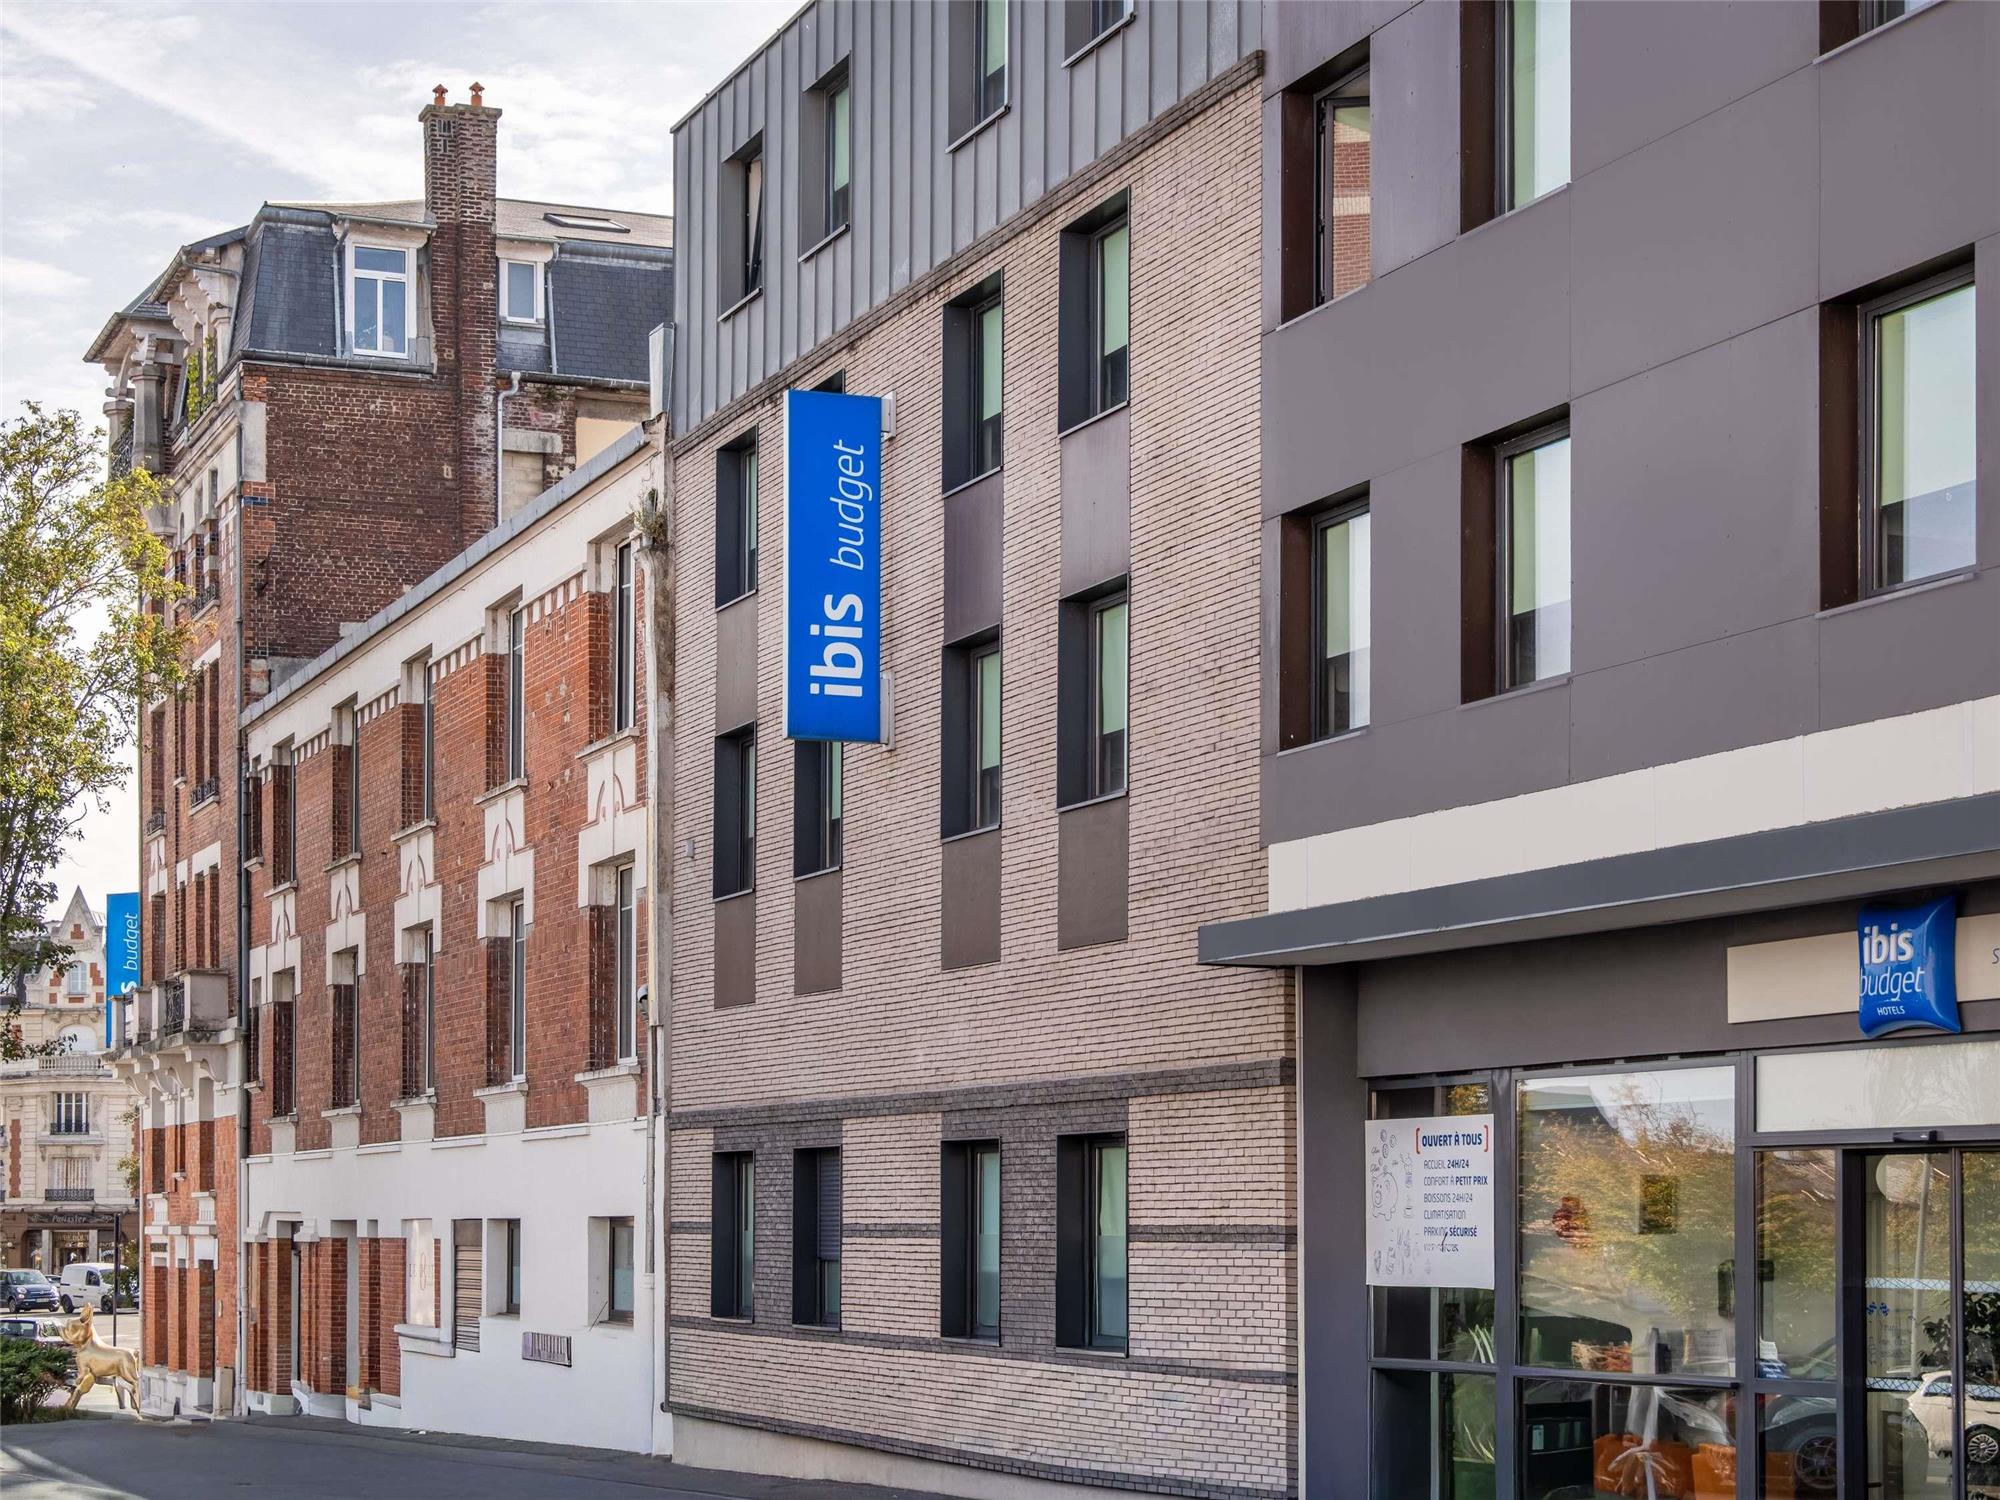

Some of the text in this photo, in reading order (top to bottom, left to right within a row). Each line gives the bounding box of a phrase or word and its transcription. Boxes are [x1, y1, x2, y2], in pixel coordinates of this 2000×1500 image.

[809, 439, 873, 697] ibis budget
[123, 912, 140, 971] budget
[1863, 923, 1914, 965] ibis
[1860, 966, 1925, 1001] budget
[1876, 1005, 1906, 1016] HOTELS
[1421, 1131, 1483, 1147] OUVERT À TOUS
[1423, 1159, 1470, 1169] ACCUEIL 24H/24
[1423, 1176, 1449, 1186] CONFORT
[1455, 1176, 1472, 1186] PETIT
[1473, 1176, 1488, 1186] PRIX
[1423, 1192, 1473, 1203] BOISSONS 24H/24
[1423, 1209, 1466, 1220] CLIMATISATION
[1449, 1225, 1478, 1237] SÉCURISÉ
